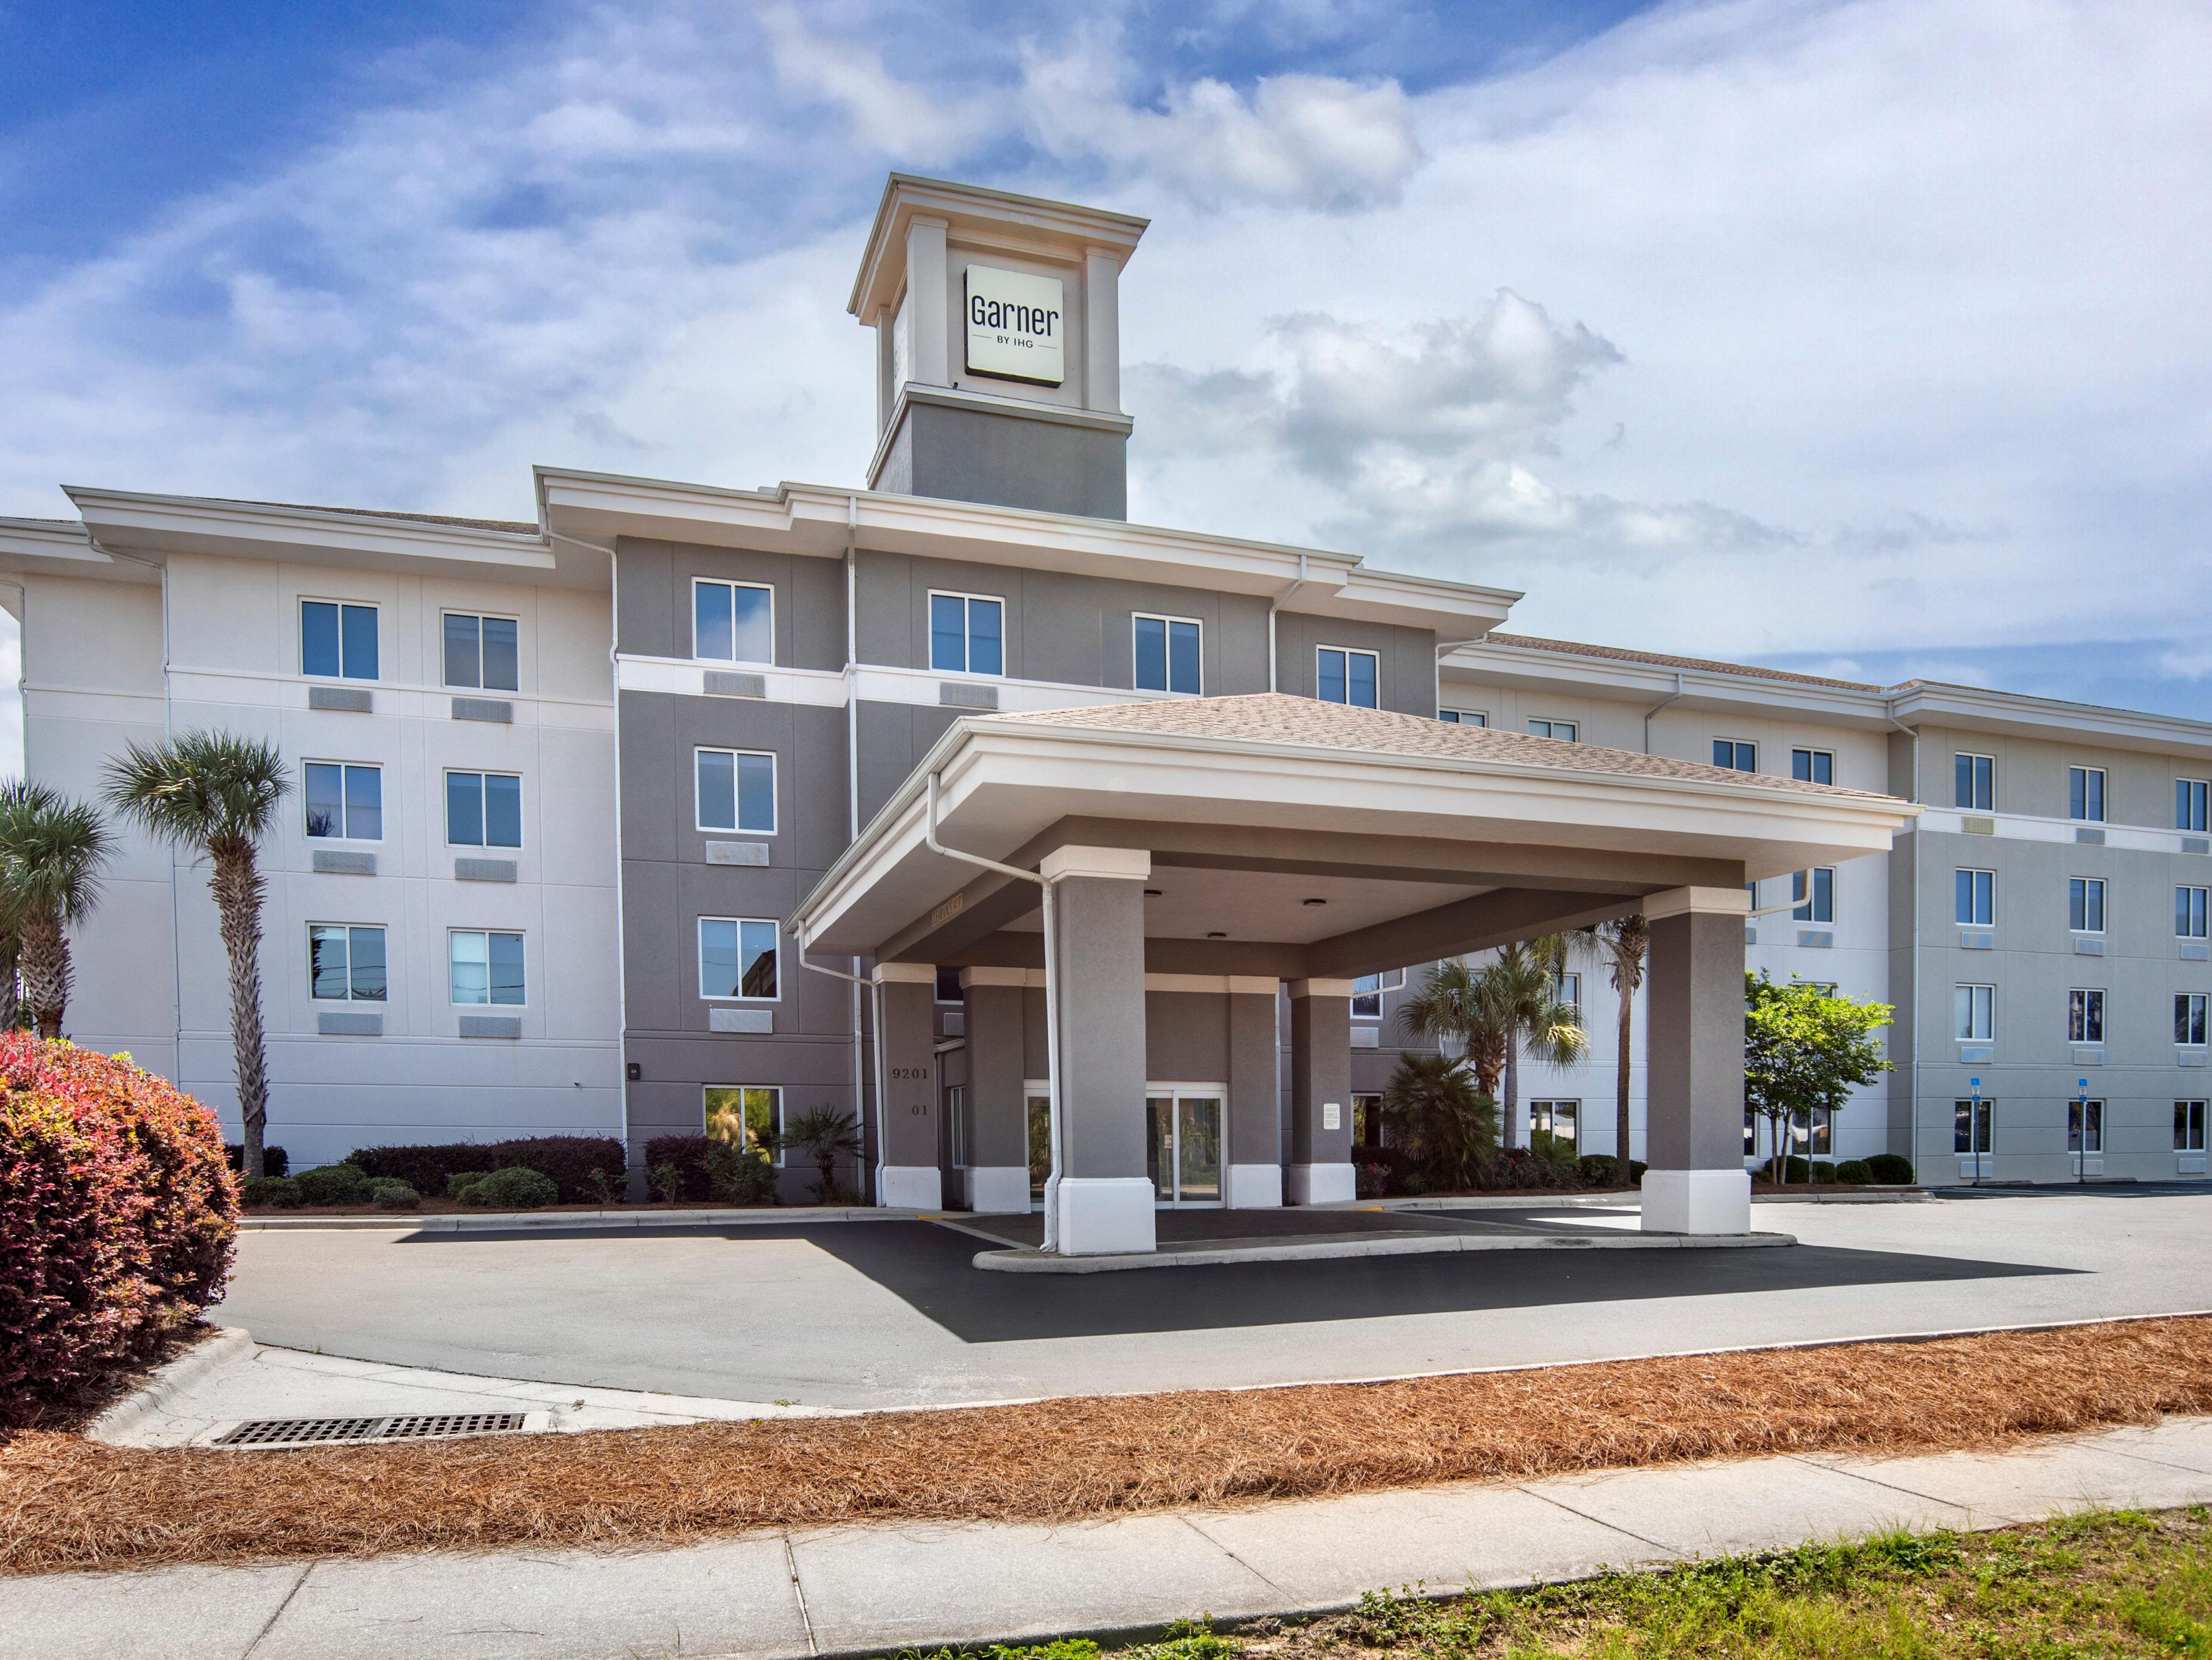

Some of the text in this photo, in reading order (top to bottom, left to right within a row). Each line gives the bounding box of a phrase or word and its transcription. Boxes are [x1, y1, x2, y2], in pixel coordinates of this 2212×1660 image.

[972, 295, 1059, 336] Garner
[997, 335, 1034, 348] BY IHG
[893, 1068, 927, 1079] 9201
[912, 1105, 927, 1116] 01
